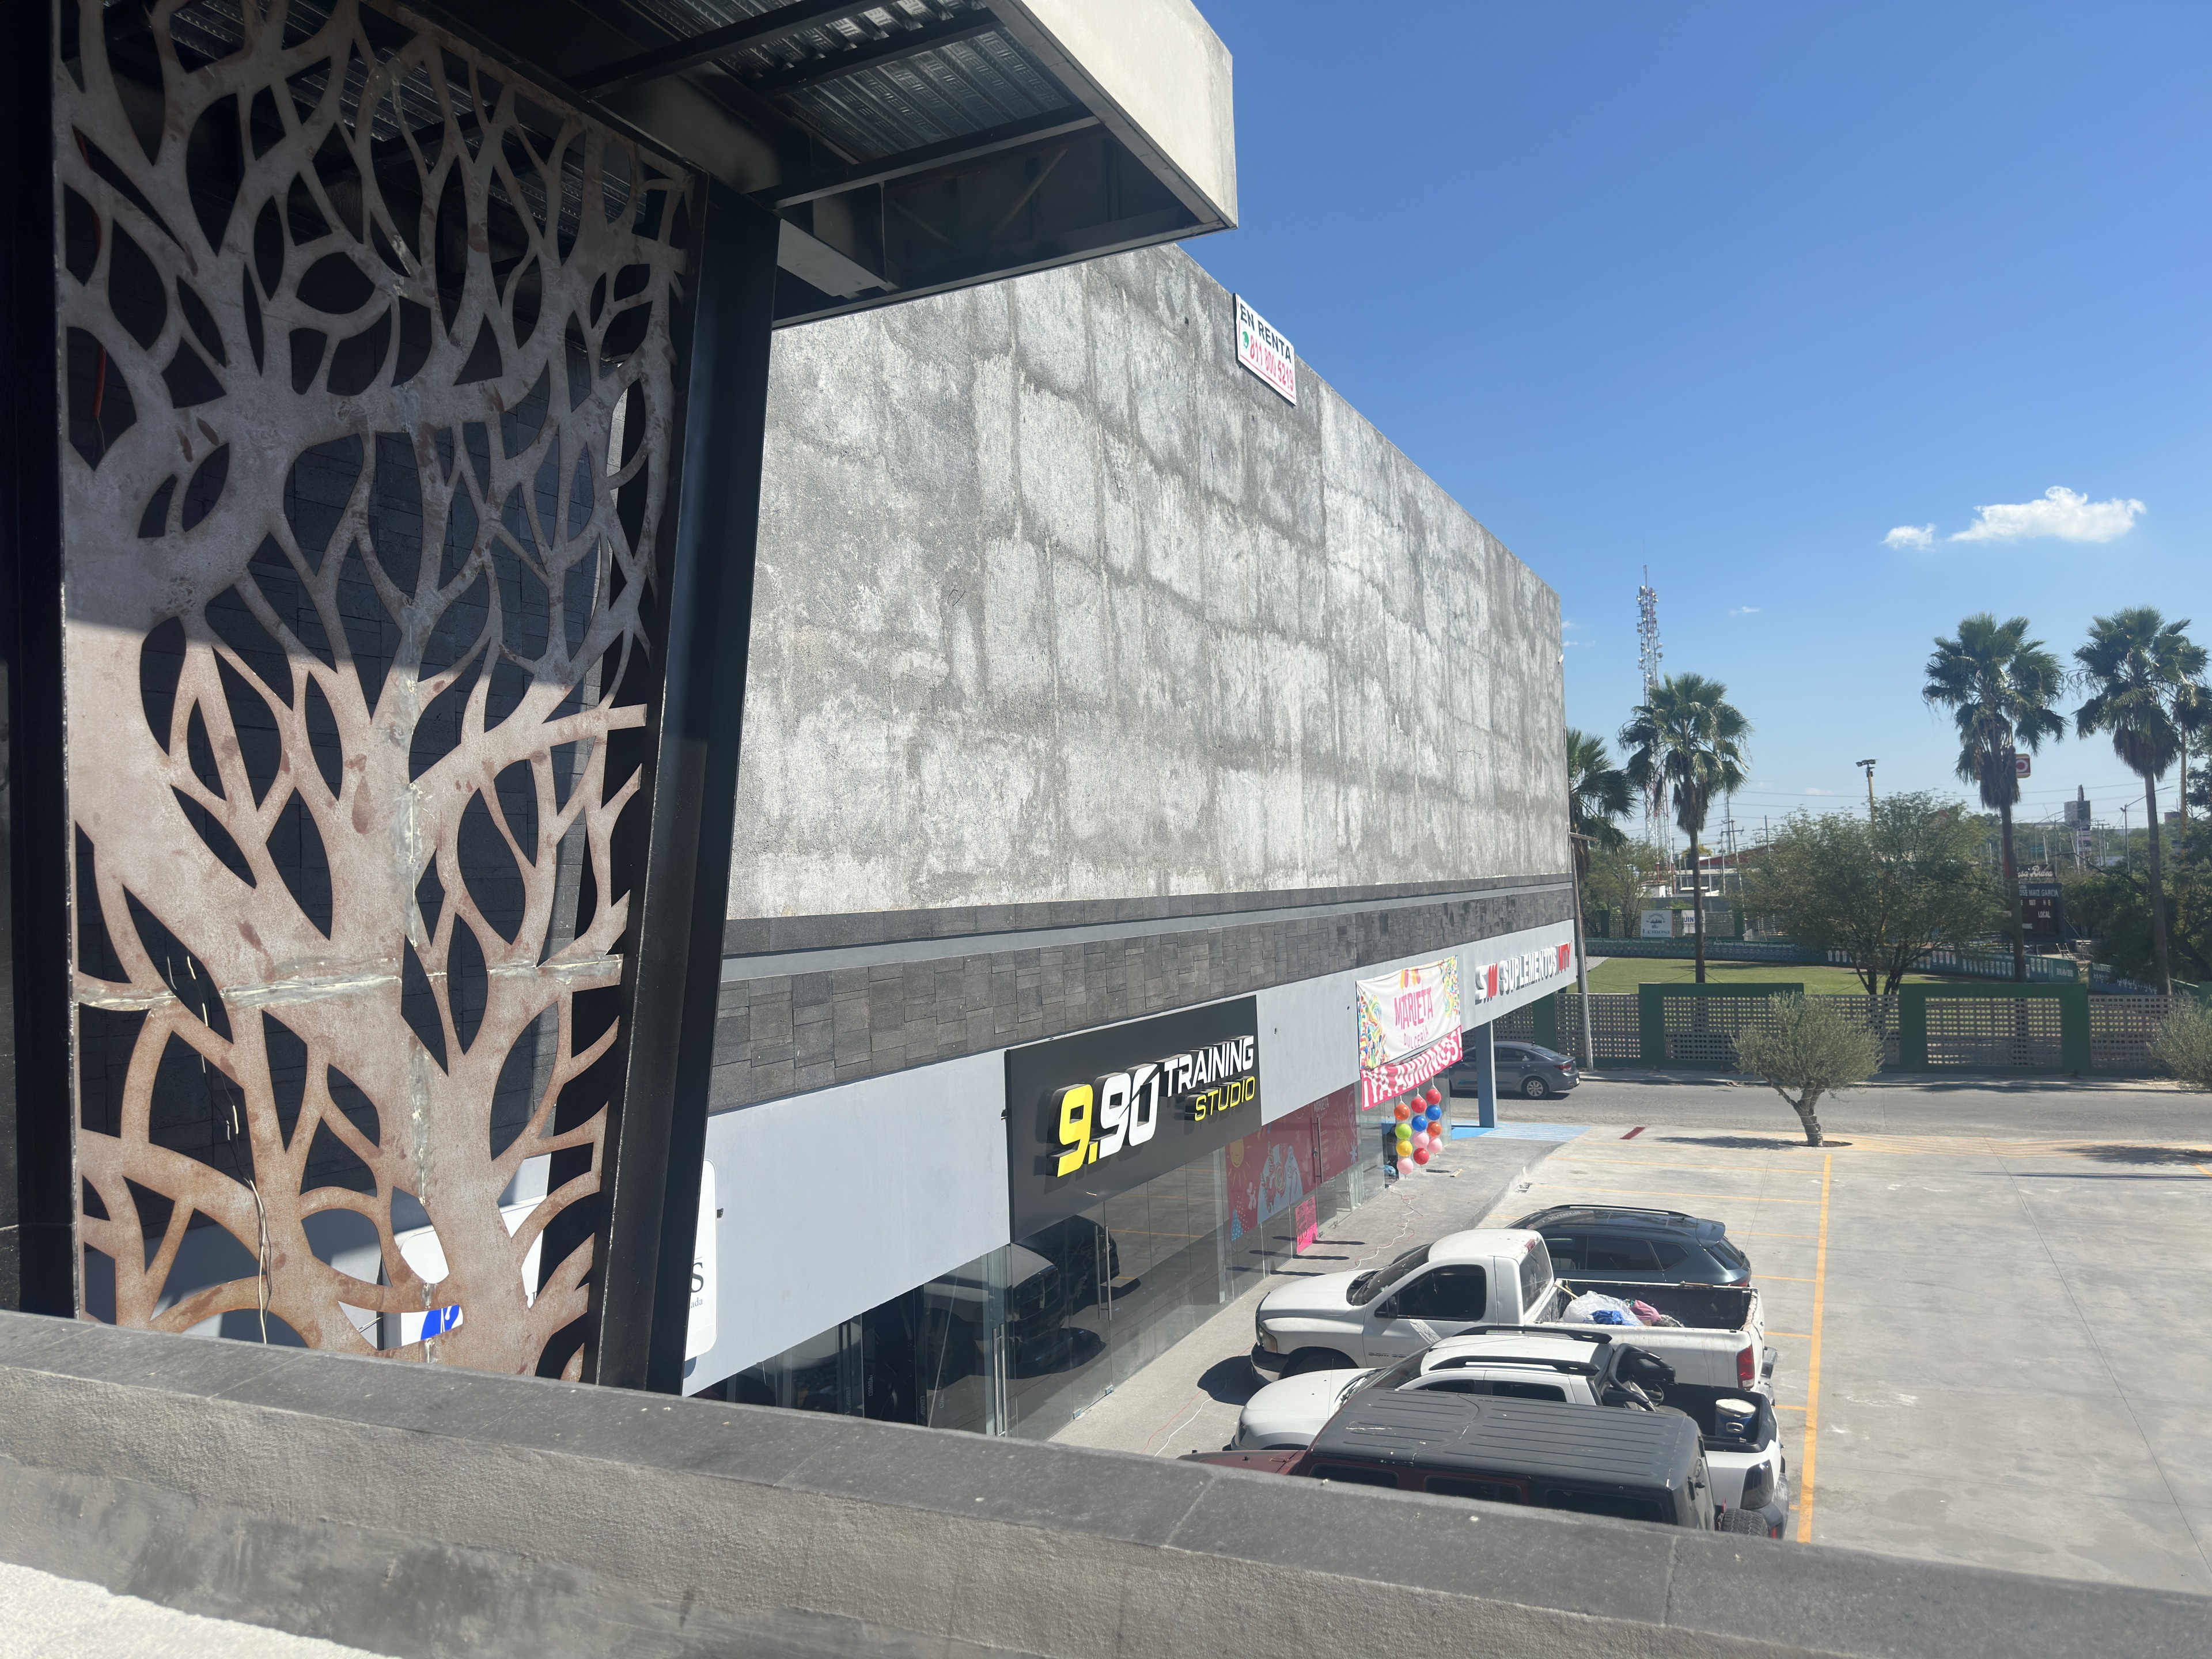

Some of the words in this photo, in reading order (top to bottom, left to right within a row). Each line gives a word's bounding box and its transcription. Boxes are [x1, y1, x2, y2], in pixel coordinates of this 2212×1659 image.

[1240, 303, 1255, 331] EN
[1258, 320, 1291, 363] RENTA
[1250, 335, 1263, 366] 811
[1264, 347, 1276, 377] 800
[1278, 360, 1294, 392] 5219
[1501, 946, 1557, 992] SUPLEMENTOS
[1558, 942, 1571, 971] MTY
[1394, 986, 1433, 1030] MARIETA
[1403, 1024, 1429, 1049] DULCERÍA
[1163, 1035, 1254, 1097] TRAINING
[1056, 1063, 1160, 1178] 9.90
[1194, 1076, 1255, 1122] STUDIO
[690, 1297, 703, 1309] ada
